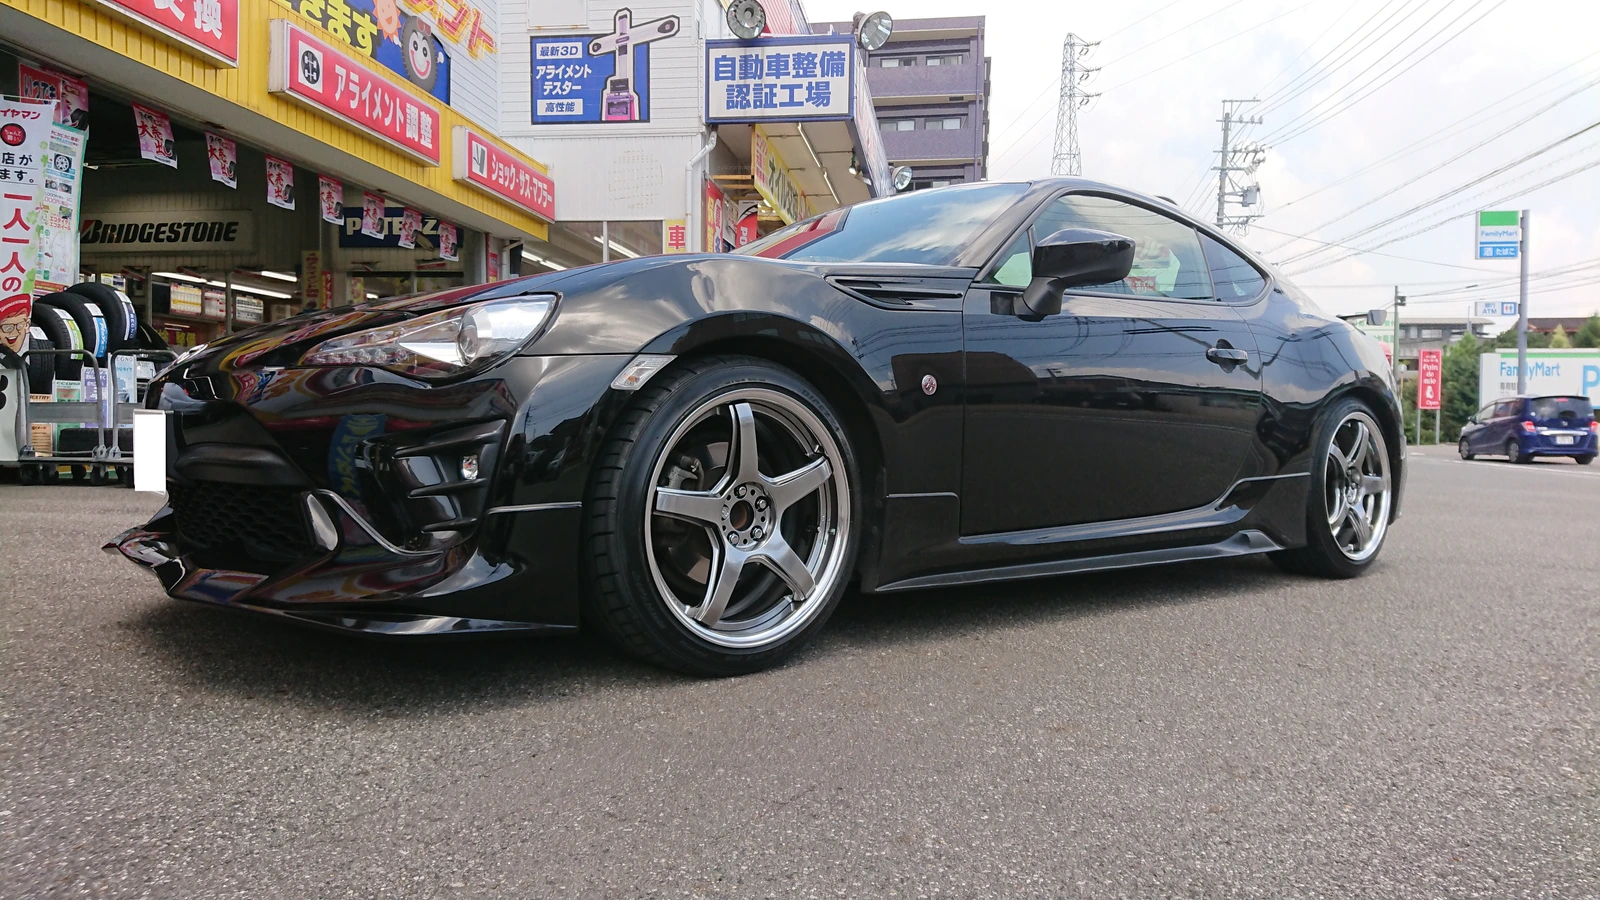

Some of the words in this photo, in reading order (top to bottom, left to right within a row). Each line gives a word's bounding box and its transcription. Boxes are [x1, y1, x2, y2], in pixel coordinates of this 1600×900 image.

[540, 45, 579, 57] 最新3D
[536, 64, 592, 79] アライメント
[714, 51, 846, 81] 自動車整備
[543, 81, 582, 96] テスター
[725, 81, 831, 110] 認証工場
[334, 64, 433, 149] アライメント調整
[544, 102, 575, 113] 高性能
[2, 152, 33, 166] 店が
[81, 220, 239, 244] BRIDGESTONE
[668, 225, 686, 250] 車
[1481, 230, 1517, 238] FamilyMart
[1500, 362, 1561, 380] FamlyMart
